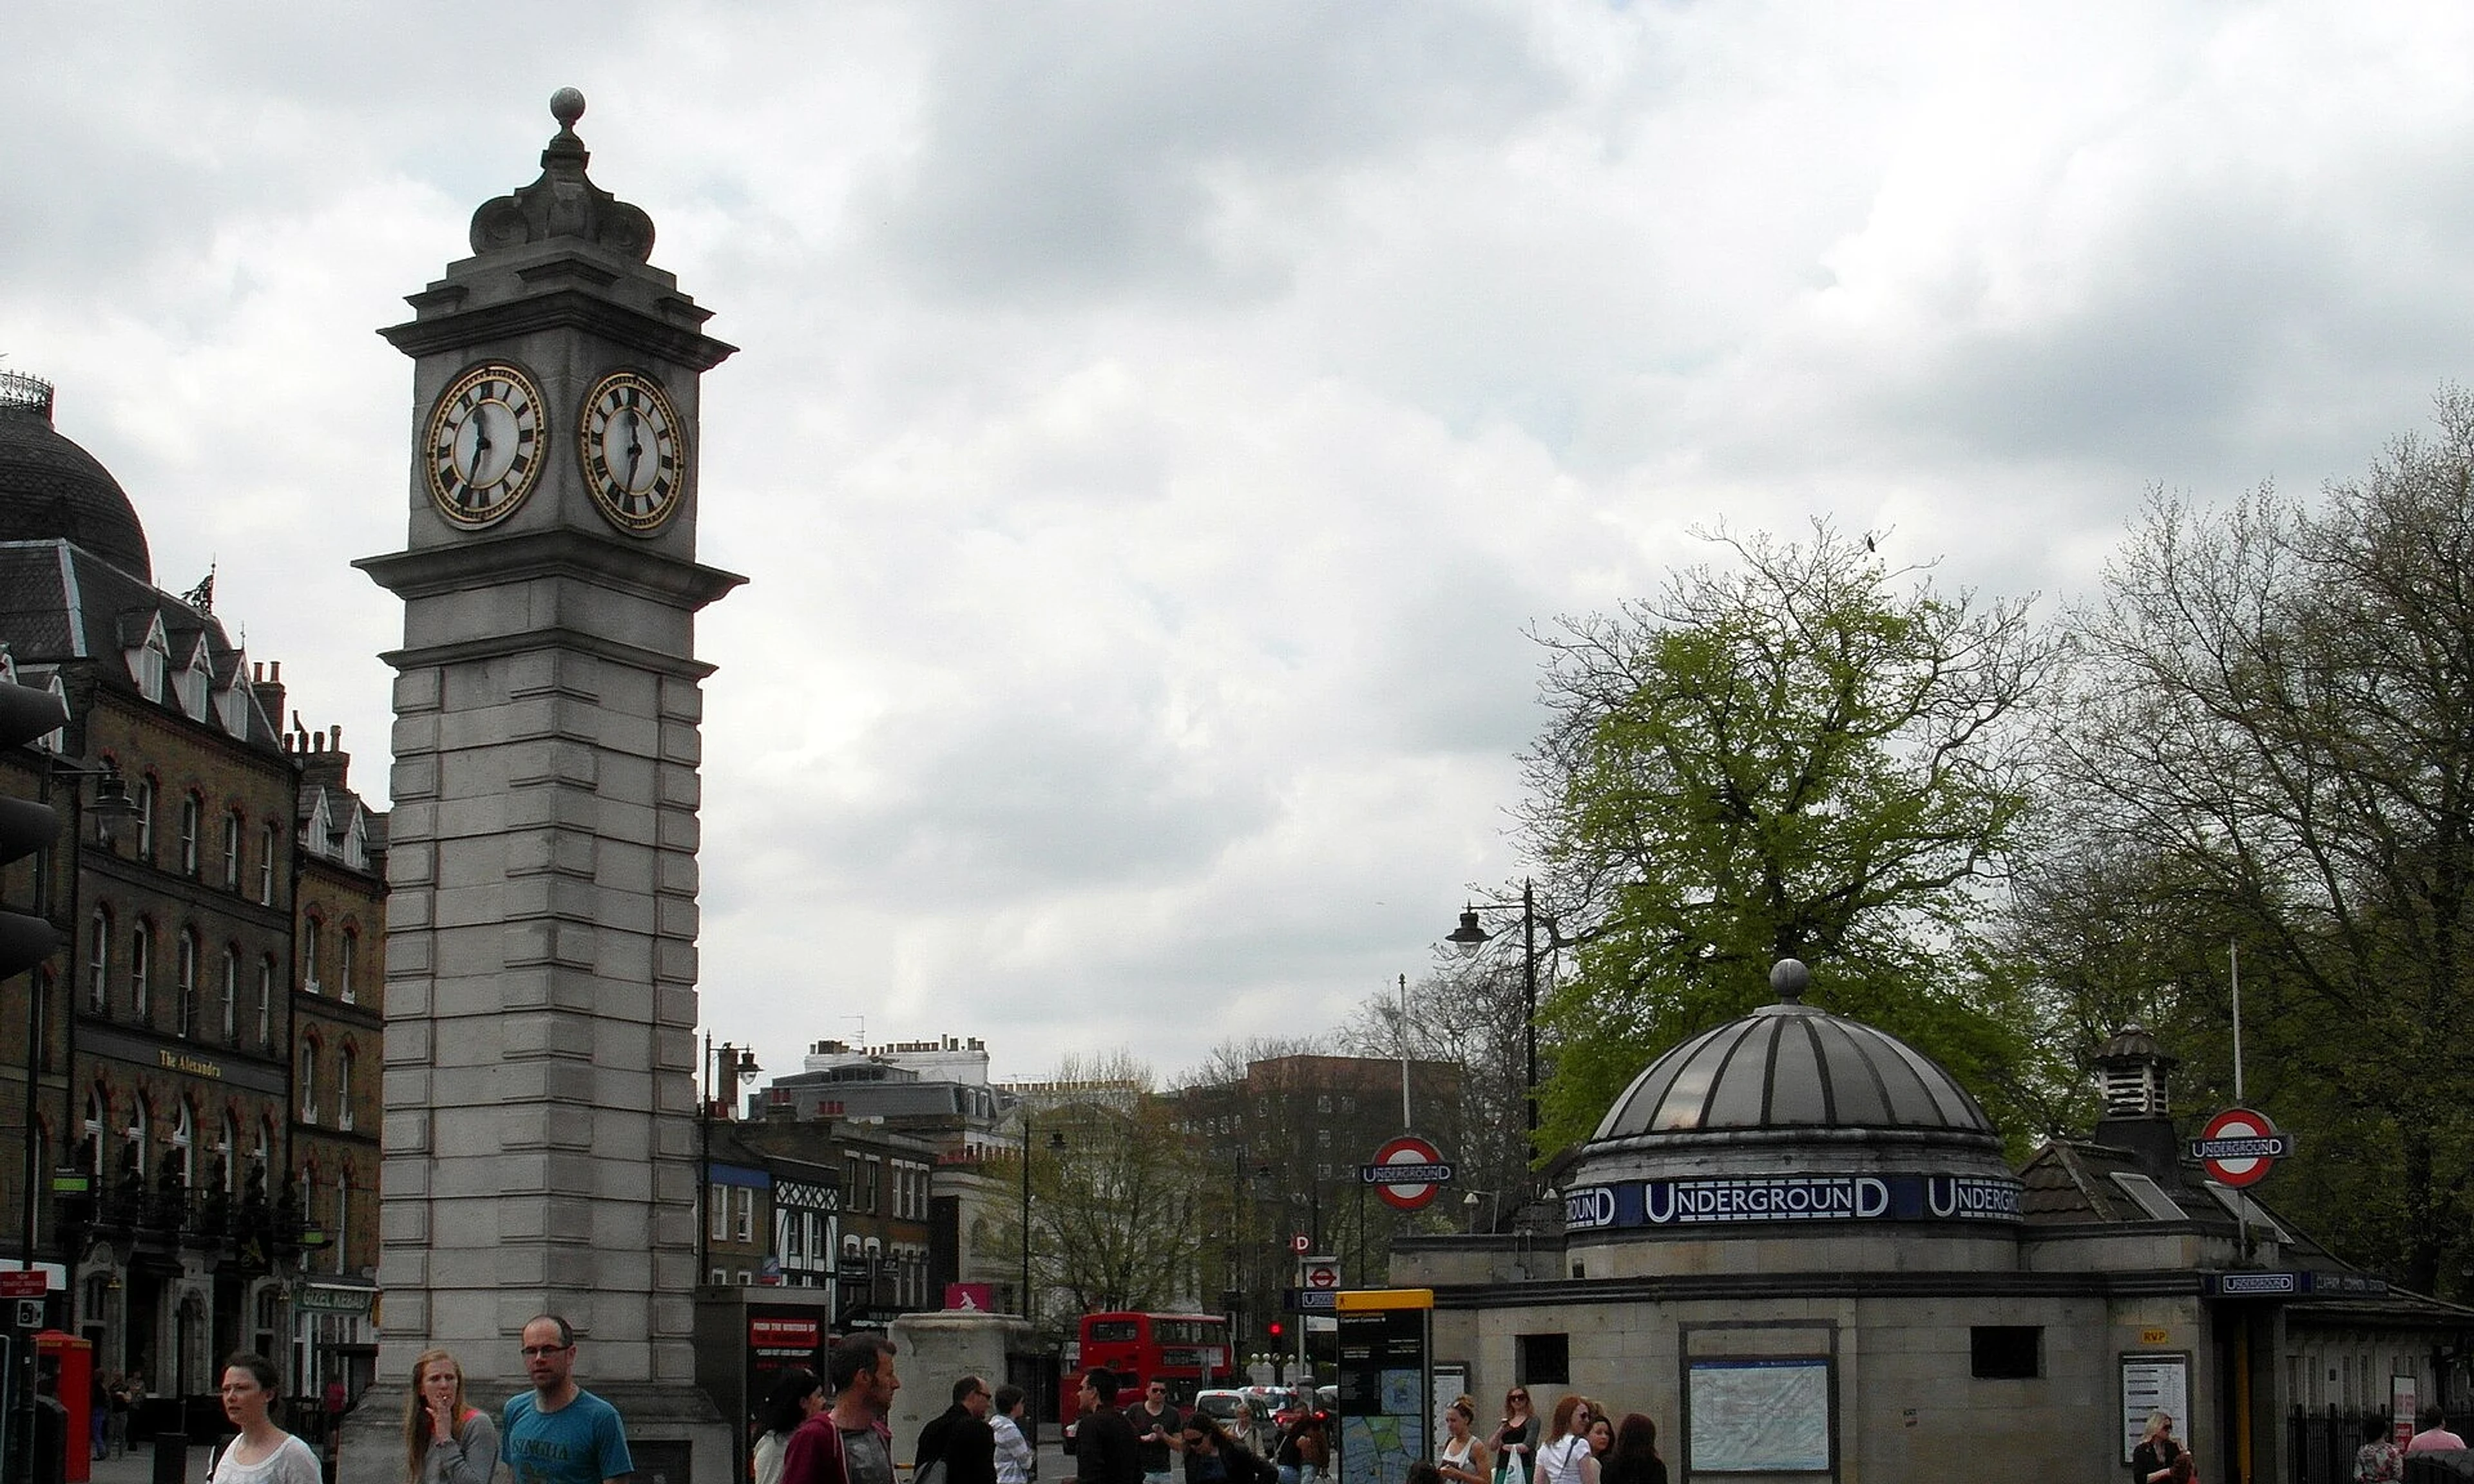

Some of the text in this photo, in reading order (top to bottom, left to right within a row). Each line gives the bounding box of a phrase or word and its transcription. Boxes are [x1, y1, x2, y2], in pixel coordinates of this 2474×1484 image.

[160, 1049, 222, 1078] The Alexandra
[2192, 1138, 2282, 1158] UNDERGROUND
[1363, 1165, 1451, 1183] UNDERGROUND
[1645, 1177, 1889, 1223] UNDERGROUND
[1296, 1236, 1309, 1250] D
[2143, 1331, 2165, 1342] RVP
